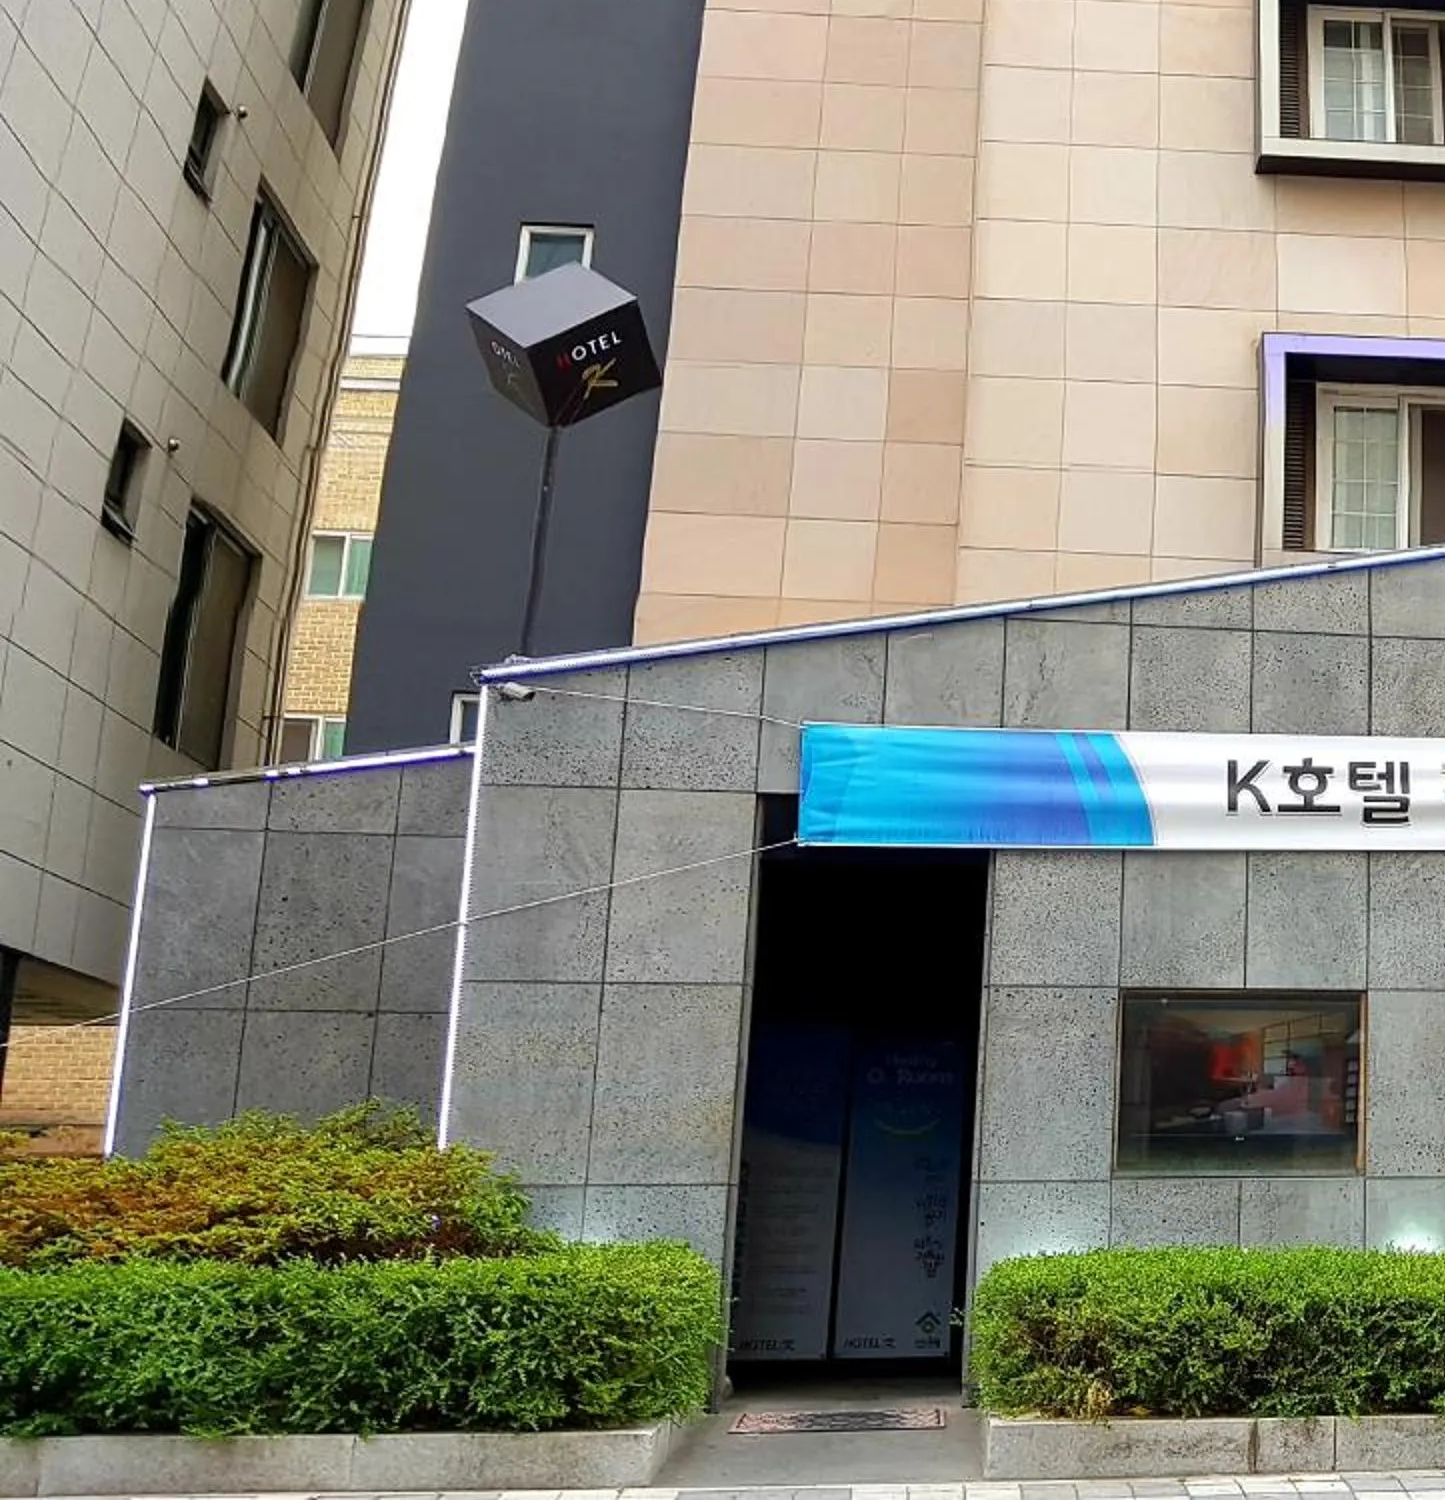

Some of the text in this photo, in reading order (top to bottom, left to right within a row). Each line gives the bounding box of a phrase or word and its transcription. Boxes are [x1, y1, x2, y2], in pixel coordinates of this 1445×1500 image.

[557, 331, 622, 369] HOTEL
[582, 357, 618, 400] K
[1227, 758, 1412, 828] K호텔
